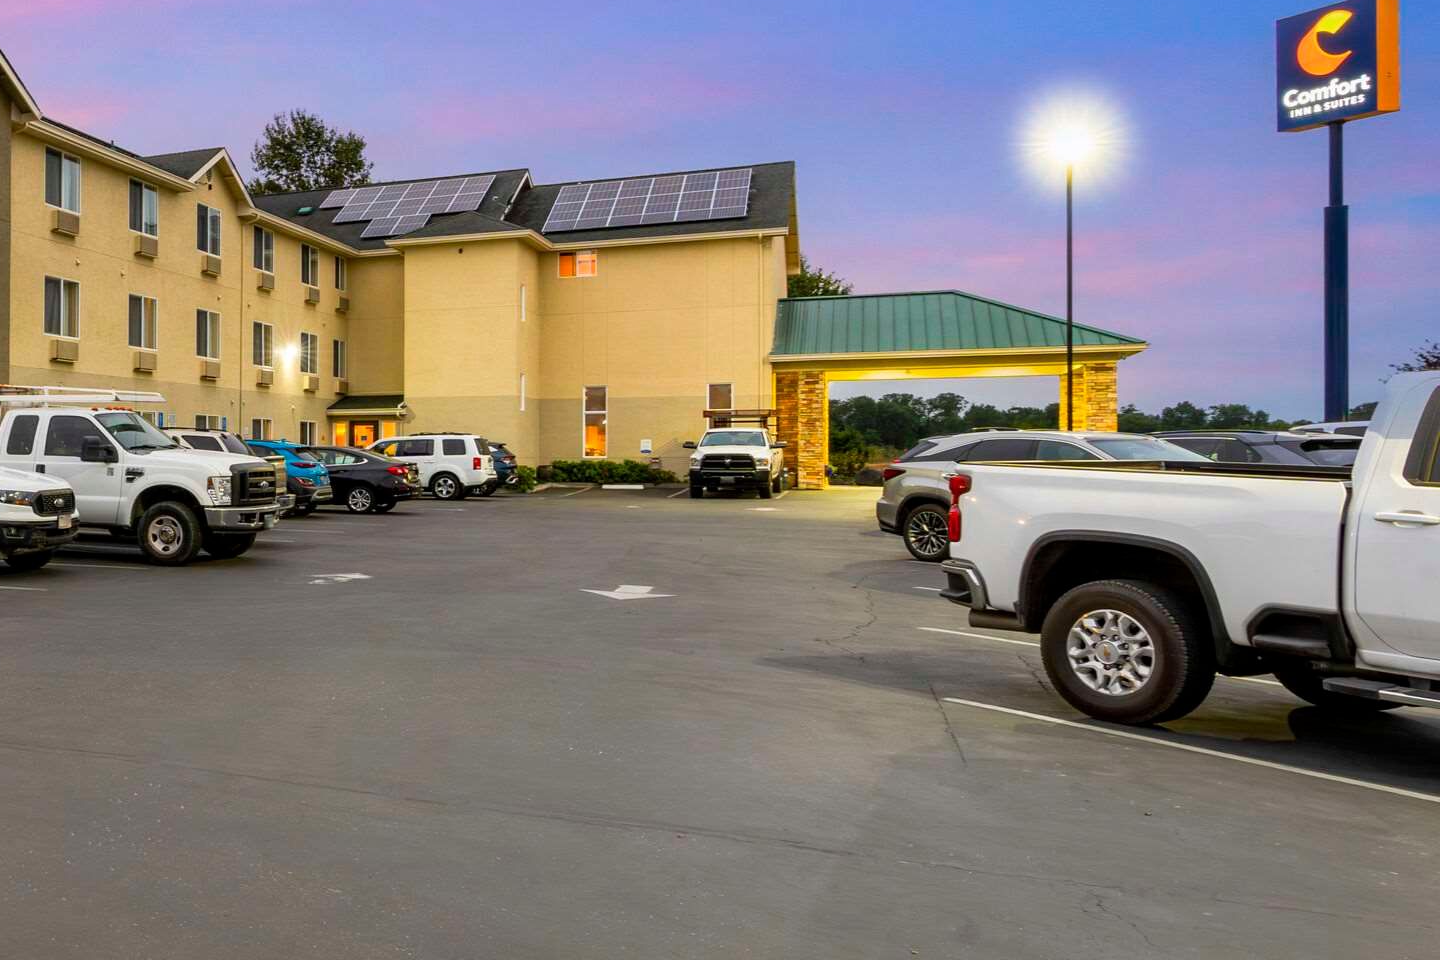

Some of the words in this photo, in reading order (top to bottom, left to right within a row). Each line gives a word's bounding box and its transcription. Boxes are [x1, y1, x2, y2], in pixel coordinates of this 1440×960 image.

[1283, 74, 1370, 107] Comfort
[1290, 106, 1312, 118] INN
[1314, 104, 1322, 113] &
[1324, 95, 1365, 110] SUITES
